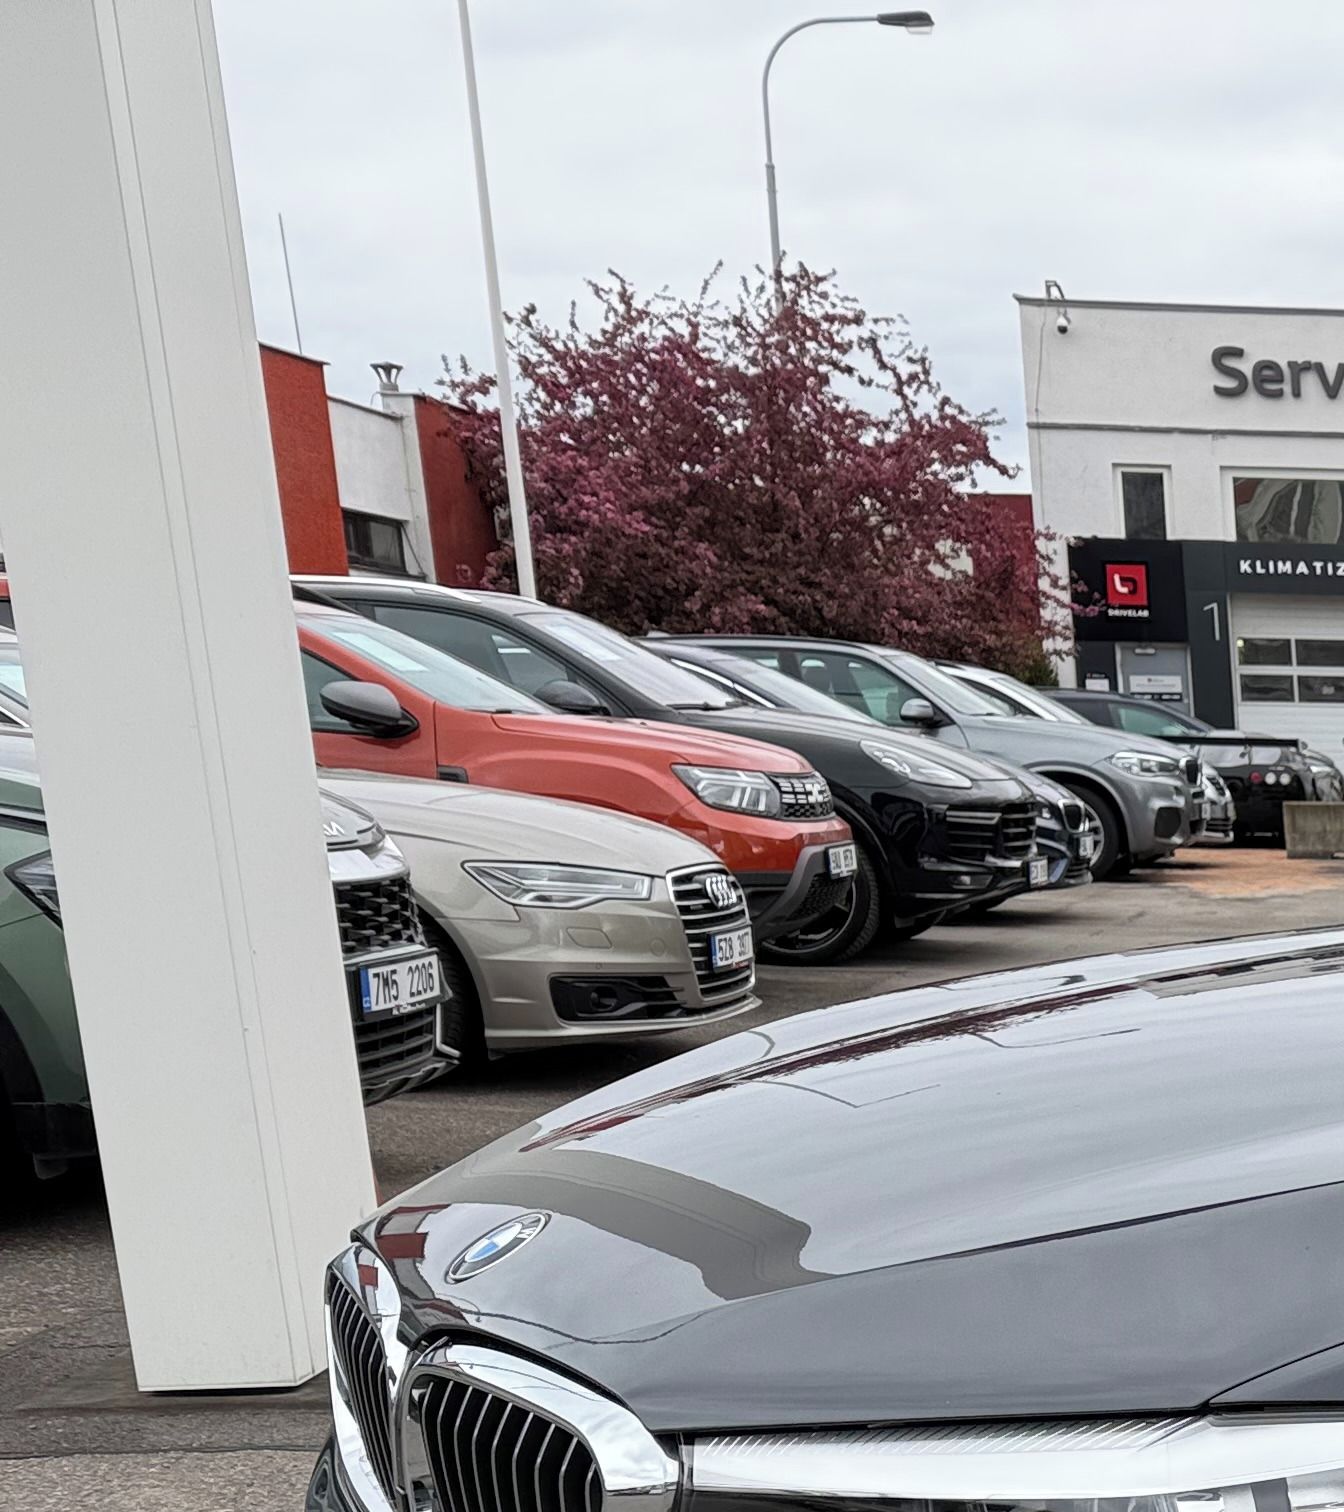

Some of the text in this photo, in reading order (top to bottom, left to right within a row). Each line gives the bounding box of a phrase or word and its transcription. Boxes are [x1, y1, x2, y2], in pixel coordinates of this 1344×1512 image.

[1203, 602, 1220, 641] 1
[372, 960, 434, 1006] 7M5 2206
